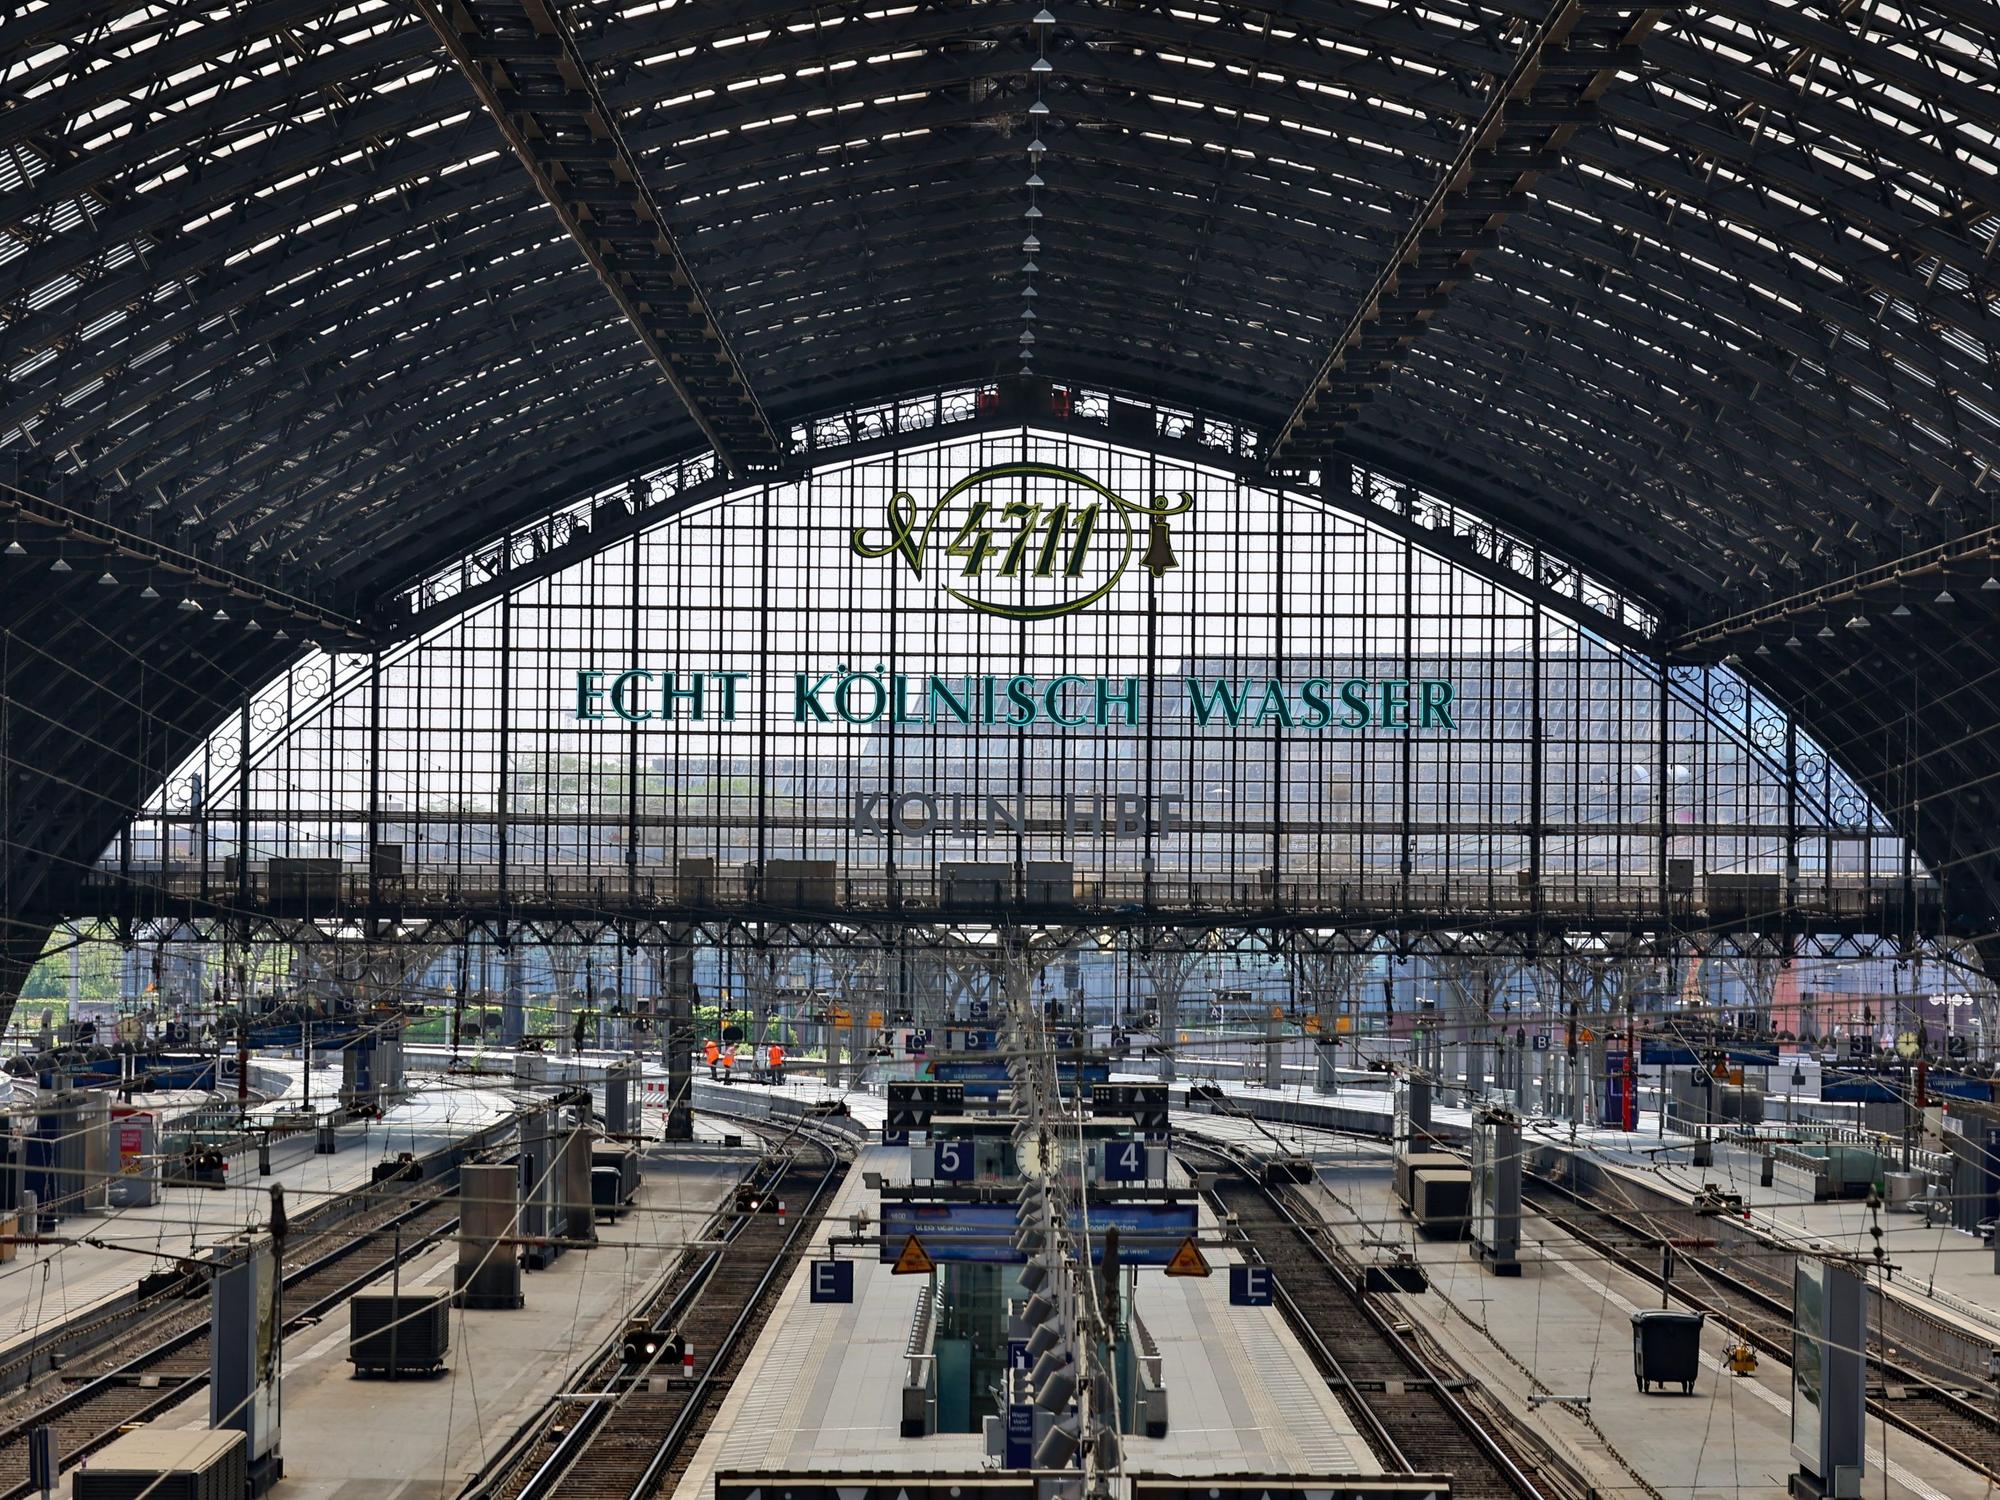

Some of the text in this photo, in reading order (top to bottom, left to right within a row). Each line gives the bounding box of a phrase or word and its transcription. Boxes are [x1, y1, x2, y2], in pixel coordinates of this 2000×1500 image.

[945, 502, 1102, 578] 4711
[576, 663, 1456, 730] ECHT KÖLNISCH WASSER
[854, 791, 1185, 840] KÖLN HBF
[972, 1001, 982, 1016] 5
[174, 1023, 184, 1039] 6
[912, 1035, 923, 1050] C
[968, 1030, 979, 1047] 5
[1538, 1036, 1547, 1048] B
[1852, 1035, 1864, 1052] 3
[1951, 1037, 1962, 1054] 2
[940, 1142, 960, 1173] 5
[1119, 1142, 1139, 1173] 4
[816, 1262, 836, 1294] E
[1247, 1267, 1267, 1297] E
